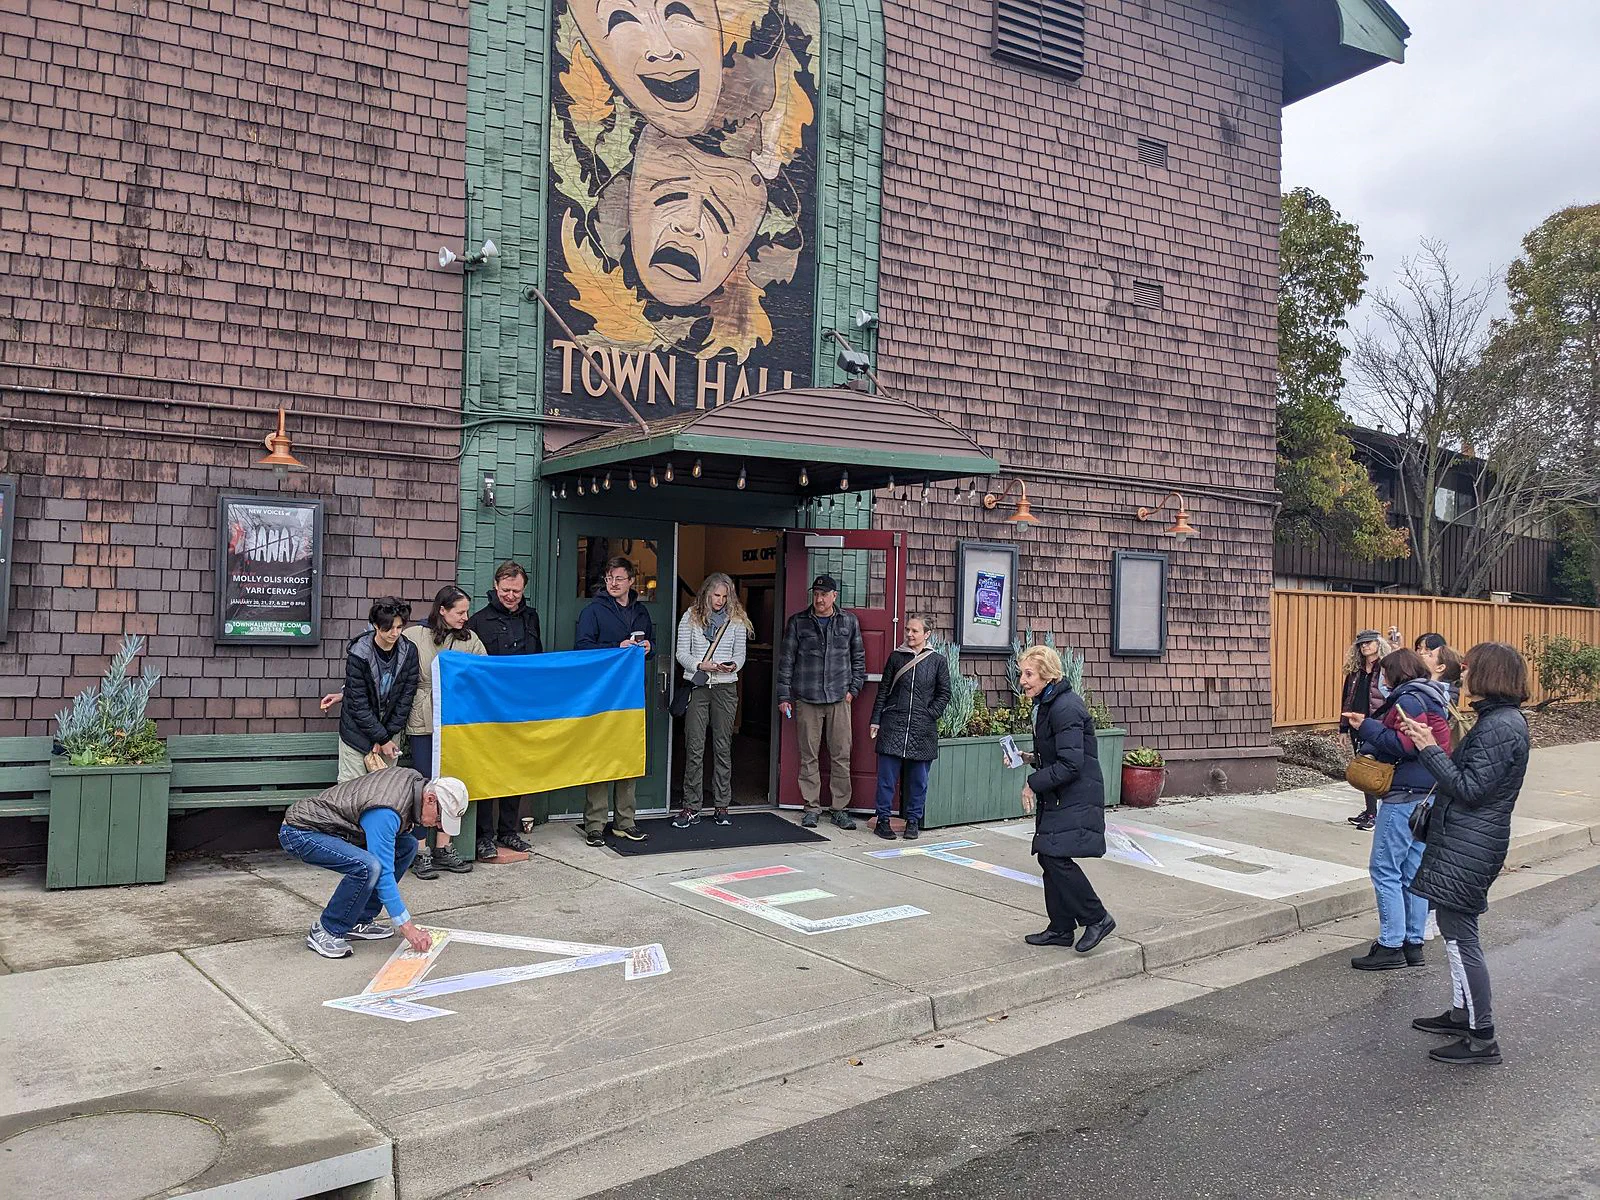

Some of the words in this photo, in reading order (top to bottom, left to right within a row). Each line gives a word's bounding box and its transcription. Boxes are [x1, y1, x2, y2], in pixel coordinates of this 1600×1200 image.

[552, 340, 677, 406] TOWN
[742, 549, 759, 562] BOX
[232, 575, 262, 583] MOLLY
